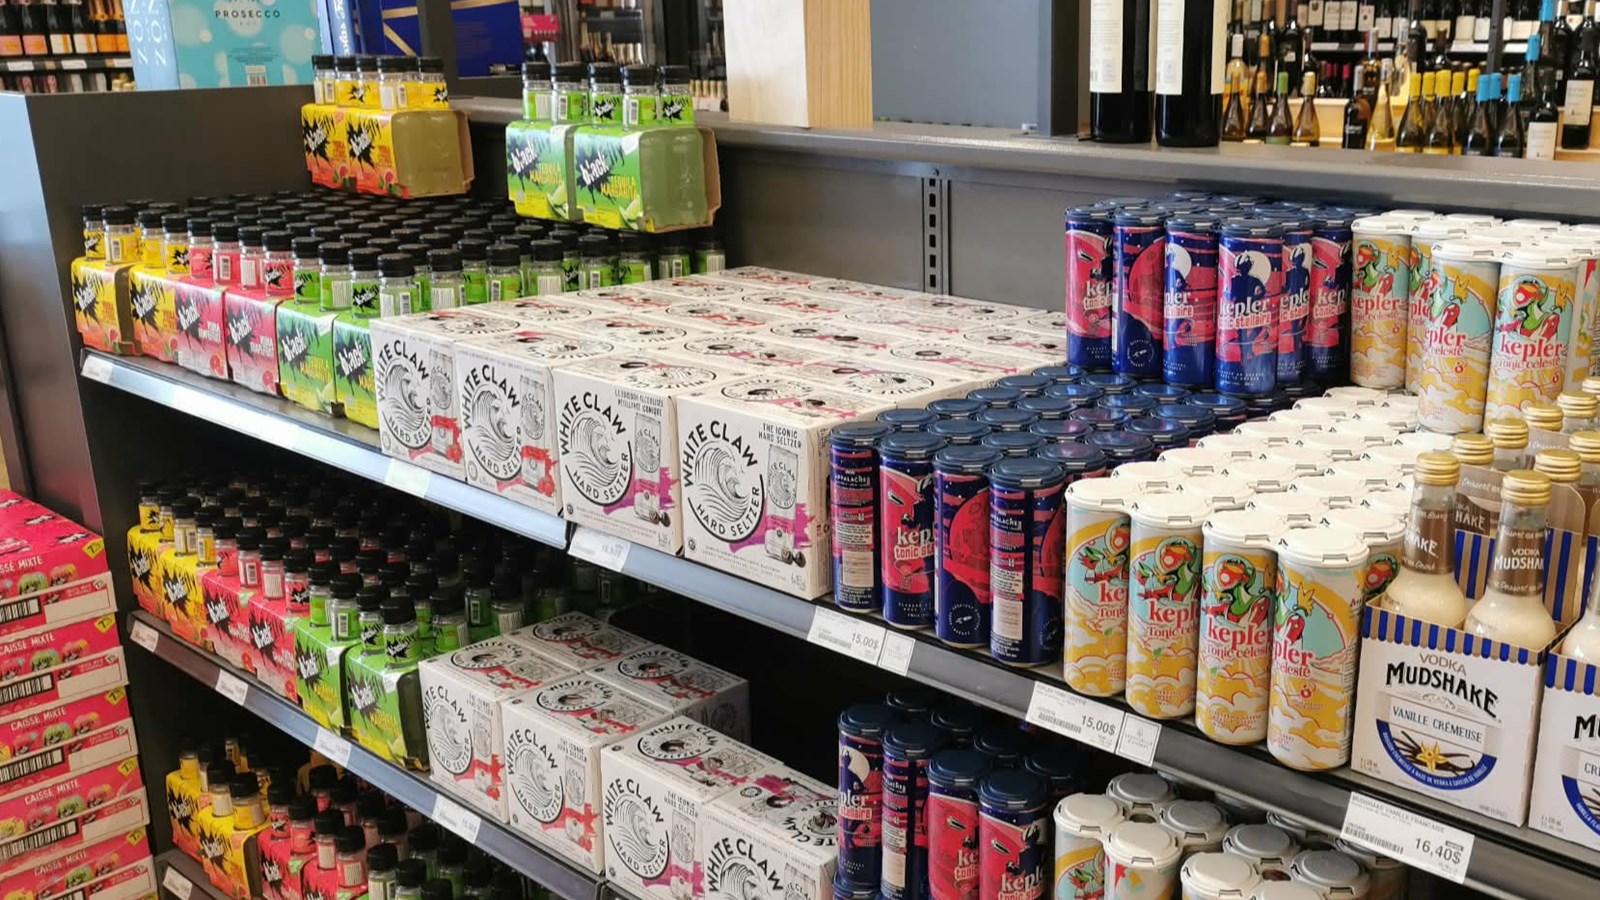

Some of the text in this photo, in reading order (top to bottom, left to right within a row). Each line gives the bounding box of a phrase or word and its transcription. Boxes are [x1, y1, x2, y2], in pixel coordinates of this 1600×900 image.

[215, 9, 281, 19] PROSECCO
[510, 139, 538, 173] black
[579, 151, 610, 186] black
[600, 182, 639, 199] MARGARITA
[610, 175, 637, 187] TEQUILA
[1219, 295, 1271, 317] kepler
[1235, 312, 1272, 328] stellaire
[228, 311, 252, 345] black
[281, 328, 306, 363] black
[337, 341, 366, 377] black
[1500, 334, 1563, 362] kepler
[376, 343, 393, 402] WHITE
[393, 340, 430, 381] CLAW
[1525, 357, 1560, 370] céleste
[459, 364, 520, 430] WHITE CLAW
[387, 417, 411, 444] HARD
[559, 391, 627, 456] WHITE CLAW
[763, 422, 798, 440] THE ICONIC
[682, 420, 758, 488] WHITE CLAW
[758, 431, 803, 449] HARD SELTZER
[474, 445, 500, 474] HARD
[572, 452, 629, 501] HARD SELTZER
[696, 504, 726, 536] HARD
[730, 485, 760, 537] SELTZER
[17, 555, 43, 569] MIXTE
[894, 546, 919, 560] tonic
[1511, 548, 1540, 556] VODKA
[31, 631, 55, 647] MIXTE
[1146, 625, 1179, 638] Tonic
[1206, 644, 1235, 659] Tonic
[1273, 638, 1314, 667] pler
[1419, 652, 1467, 676] VODKA
[549, 680, 593, 691] WHITE
[1386, 661, 1499, 719] MUDSHAKE
[10, 707, 67, 732] CAISSE MIXTE
[423, 685, 439, 730] WHITE
[437, 685, 467, 724] CLAW
[648, 723, 719, 747] WHITE CLAW
[1081, 714, 1116, 736] 15,00$
[1392, 705, 1483, 744] VANILLE CRÉMEUSE
[453, 737, 470, 772] SELTZER
[505, 728, 558, 776] WHITE CLAW
[24, 779, 80, 806] CAISSE MIXTE
[517, 783, 560, 820] HARD SELTZER
[604, 777, 665, 827] WHITE CLAW
[782, 816, 811, 843] CLAW
[34, 850, 87, 877] CAISSE MIXTE
[616, 838, 666, 876] HARD SELTZER
[706, 837, 784, 893] WHITE CLAW
[1415, 837, 1462, 865] 16,40$
